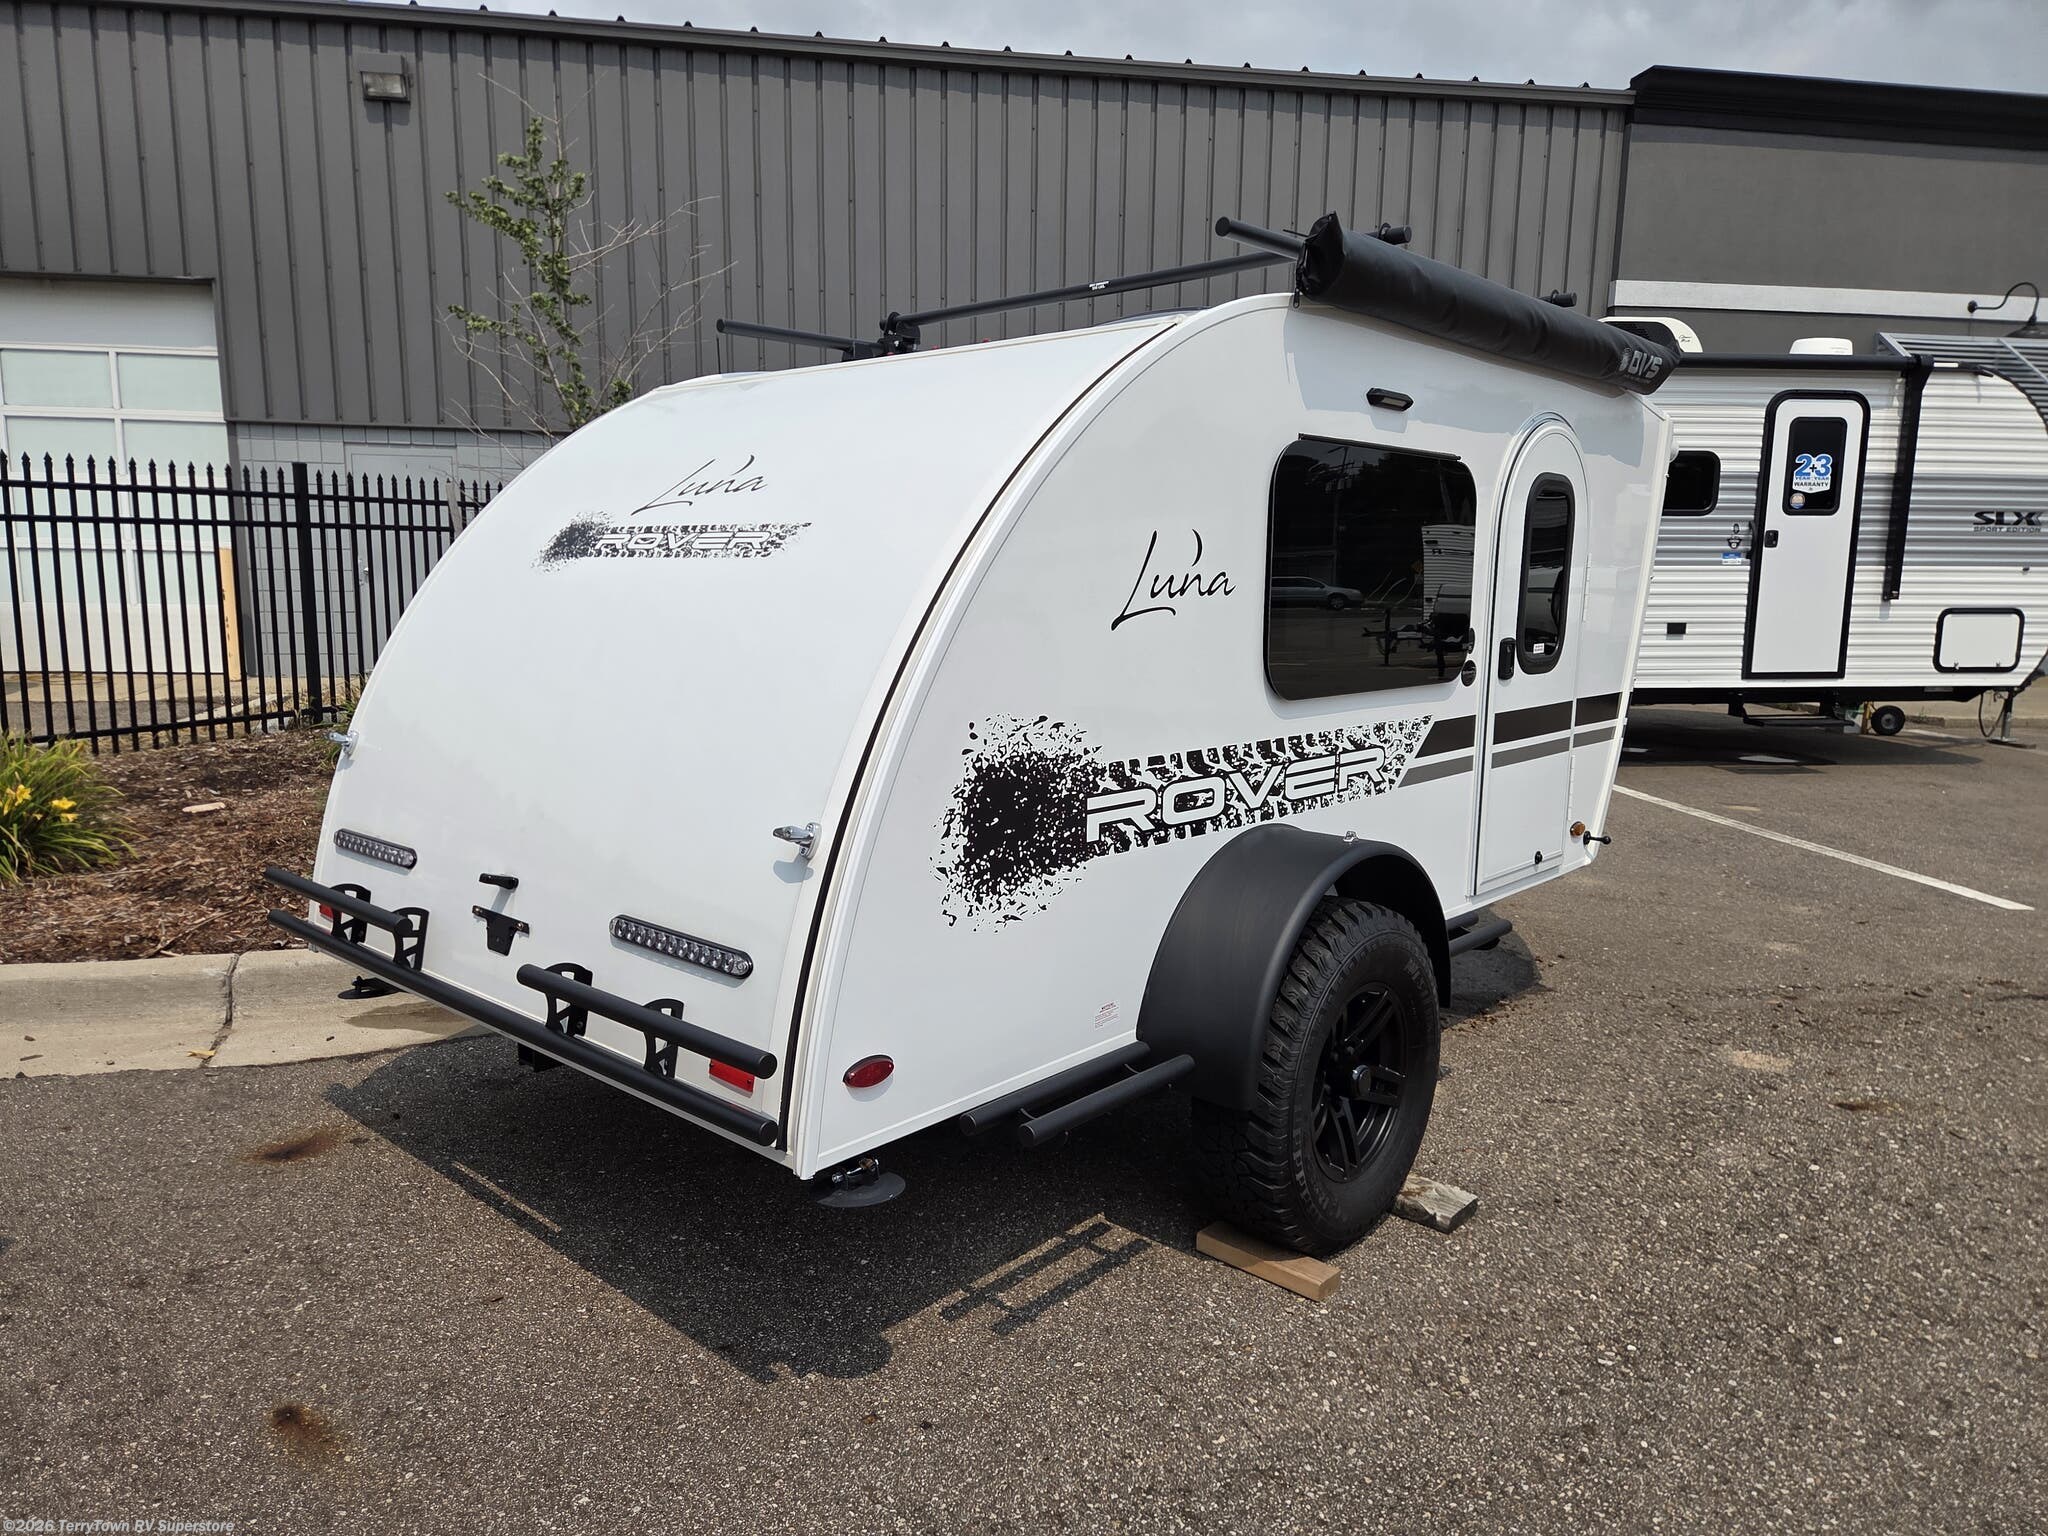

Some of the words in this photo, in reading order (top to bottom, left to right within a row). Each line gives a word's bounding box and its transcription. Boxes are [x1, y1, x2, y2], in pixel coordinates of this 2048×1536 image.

[631, 454, 768, 516] Luna
[594, 531, 771, 551] ROVER
[1972, 511, 2042, 526] SLX
[1110, 528, 1237, 632] Luna
[1085, 748, 1387, 843] ROVER
